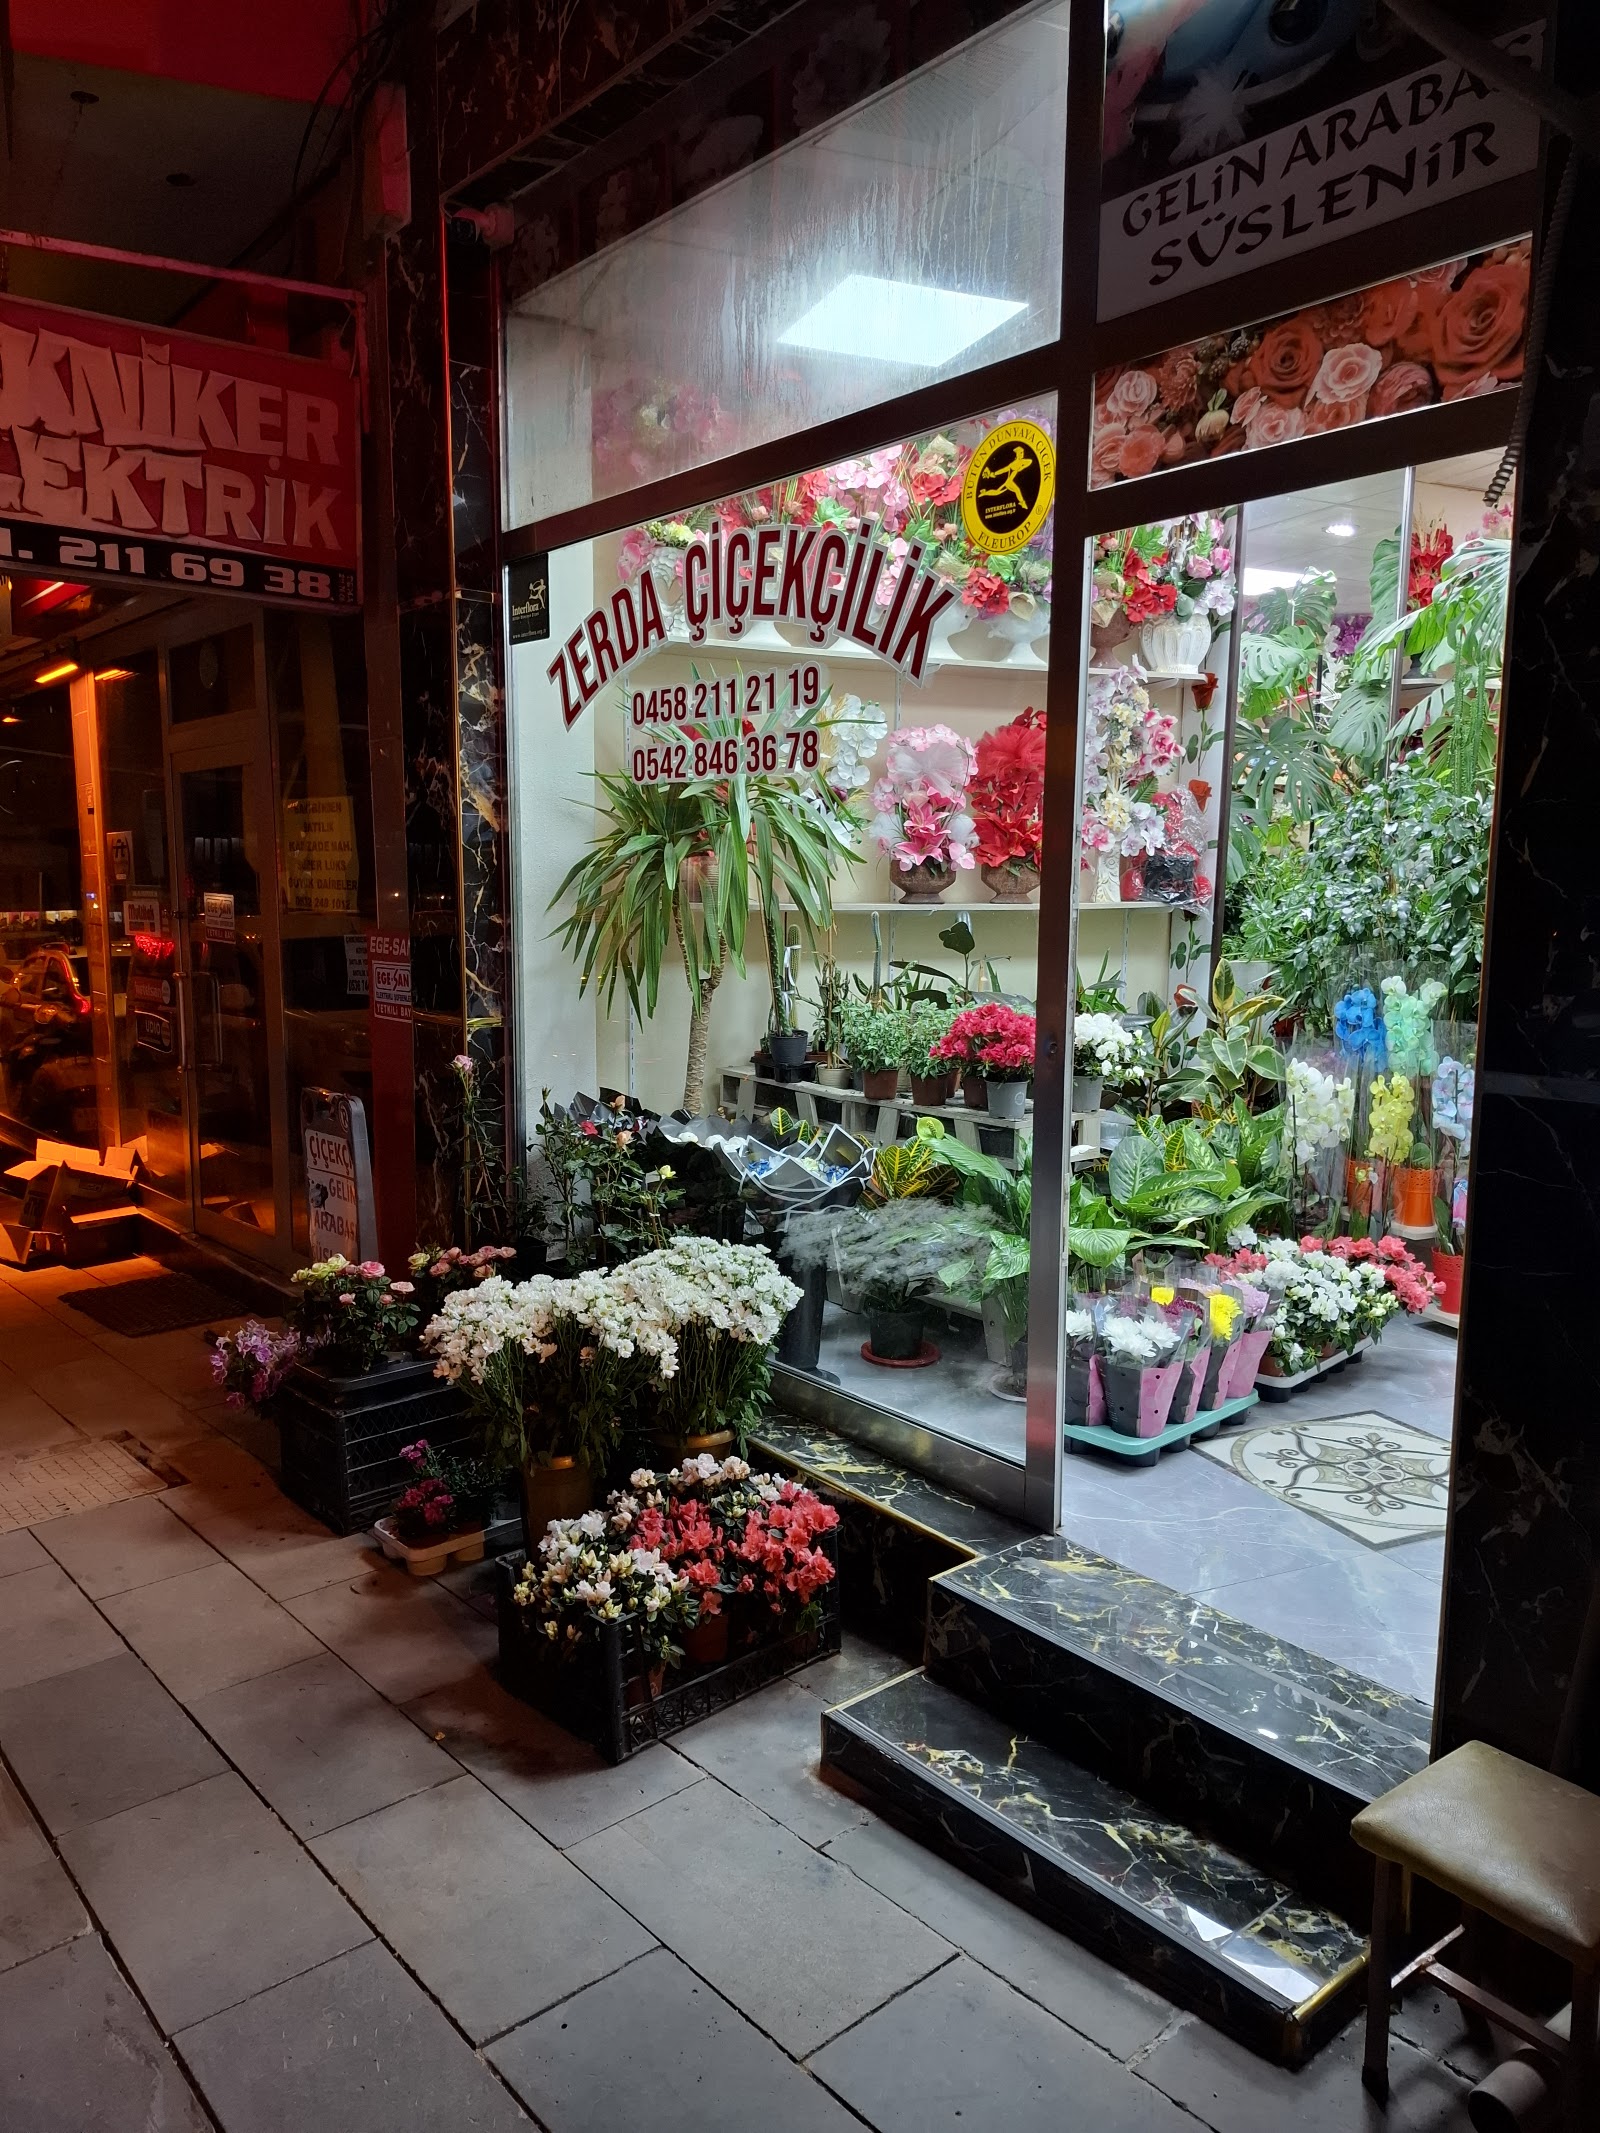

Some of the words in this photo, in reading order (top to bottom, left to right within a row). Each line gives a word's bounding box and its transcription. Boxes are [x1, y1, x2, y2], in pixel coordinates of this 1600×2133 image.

[1121, 143, 1267, 237] GELİN
[1149, 122, 1500, 286] SÜSLENİR
[978, 521, 1031, 549] FLEUROP
[59, 536, 146, 575] 211
[170, 551, 244, 587] 69
[263, 565, 331, 599] 38
[512, 601, 539, 616] Interflora
[550, 570, 666, 726] ZERDA
[685, 518, 955, 674] ÇİÇEKÇİLİK
[633, 686, 687, 725] 0458
[695, 678, 736, 718] 211
[747, 673, 775, 712] 21
[788, 666, 819, 706] 19
[633, 744, 687, 782] 0542
[694, 739, 738, 777] 846
[746, 734, 777, 773] 36
[786, 730, 818, 769] 78
